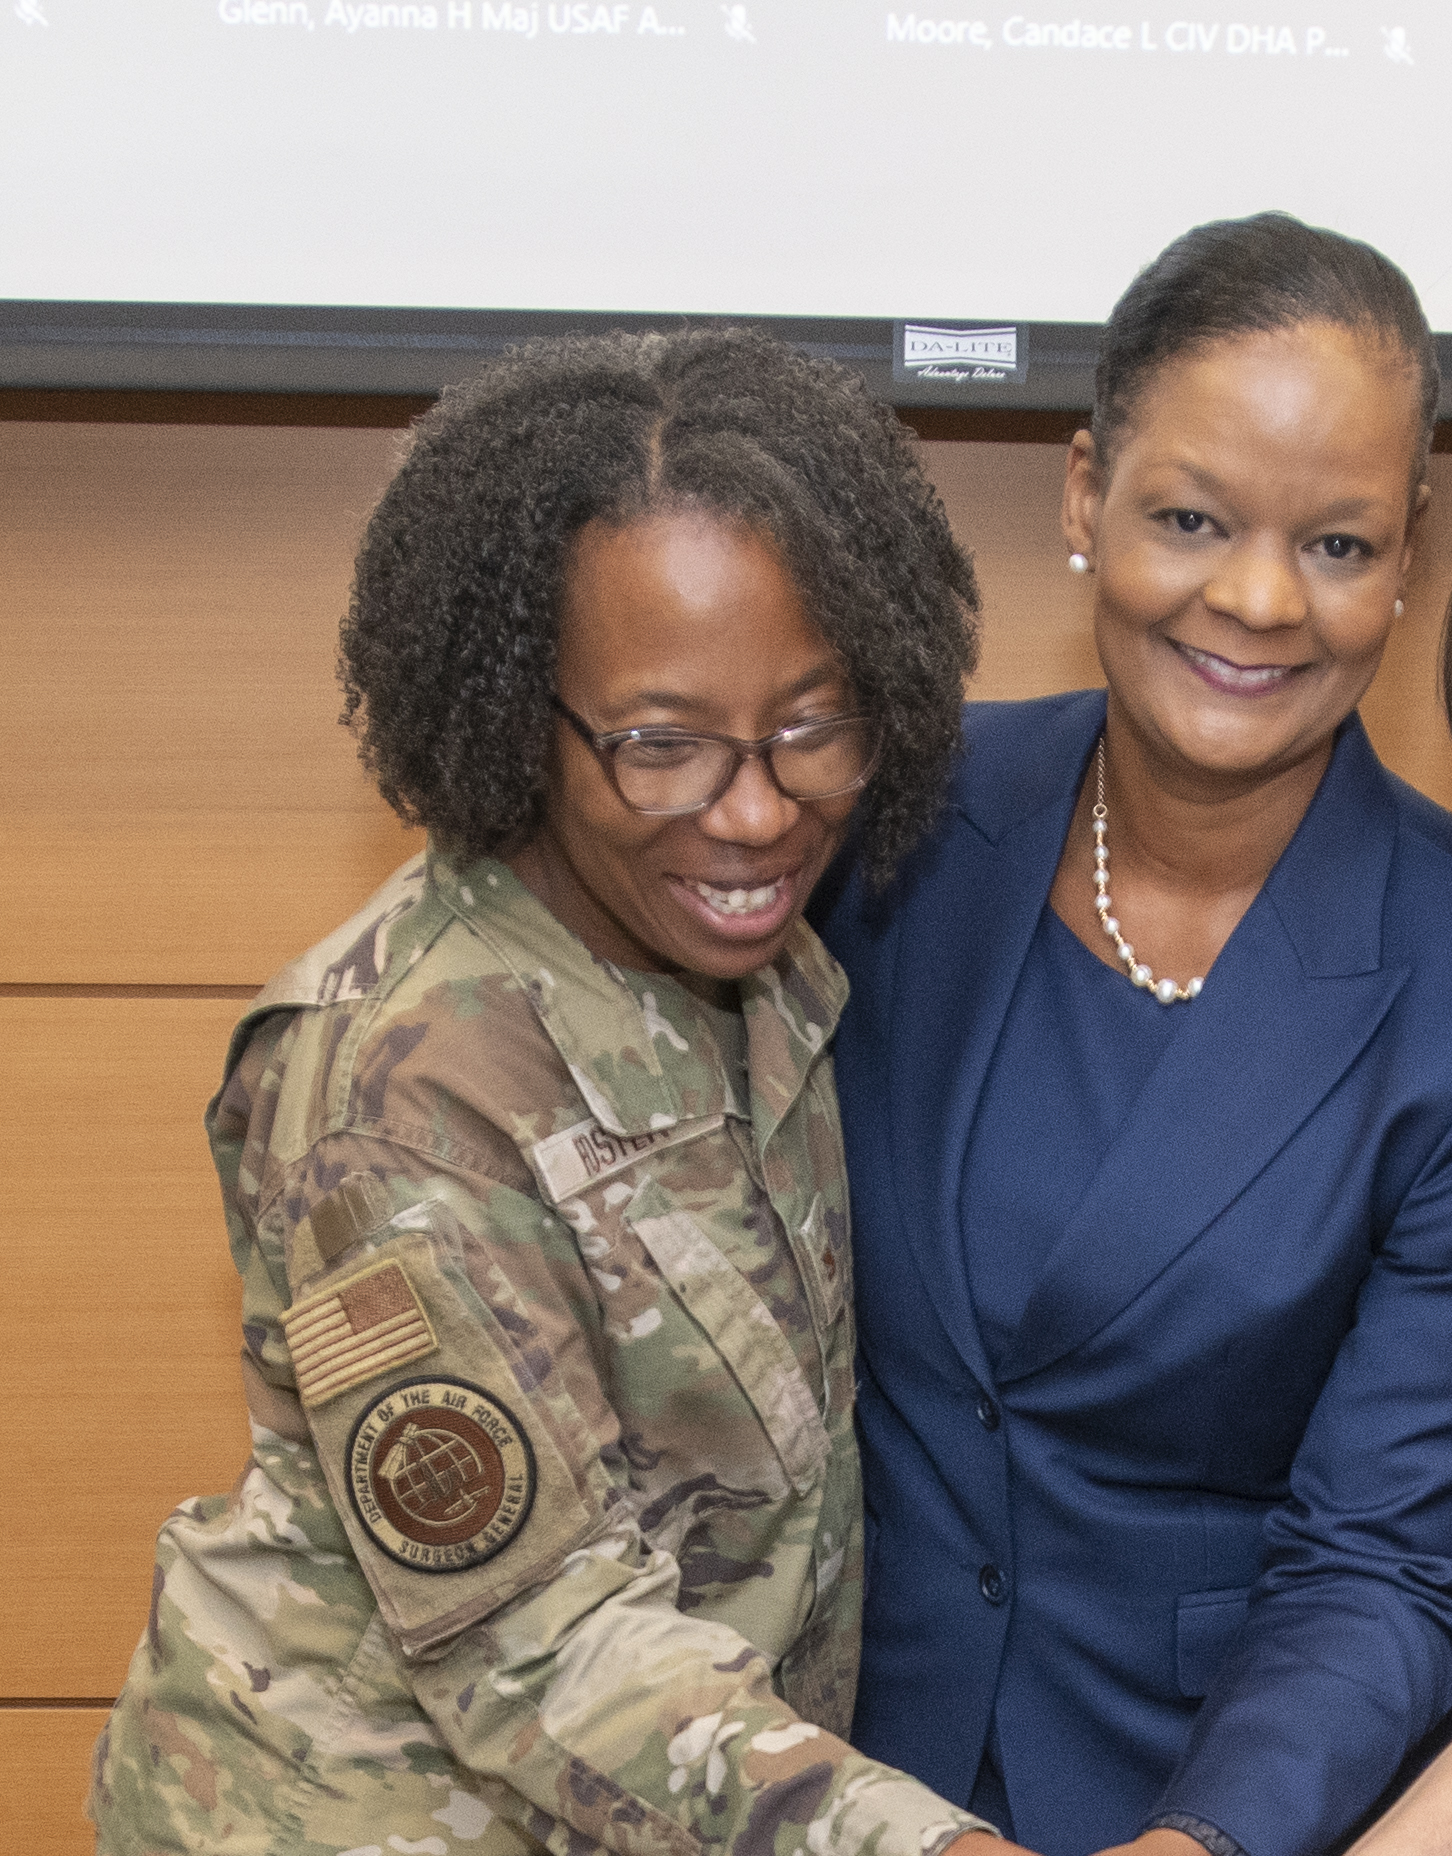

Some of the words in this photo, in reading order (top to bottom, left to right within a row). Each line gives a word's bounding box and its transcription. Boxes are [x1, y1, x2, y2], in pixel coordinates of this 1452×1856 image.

[218, 0, 315, 31] Glenn,
[325, 0, 439, 33] Ayanna
[448, 0, 472, 30] H
[482, 2, 539, 39] Maj
[548, 4, 628, 34] USAF
[887, 13, 993, 50] Moore,
[1003, 16, 1133, 50] Candace
[1141, 22, 1158, 51] L
[1165, 21, 1220, 53] CIV
[1226, 25, 1298, 55] DHA
[911, 341, 1013, 353] DA-LITE
[353, 1424, 384, 1525] DEPARTMENT
[377, 1404, 395, 1423] OF
[402, 1389, 431, 1408] THE
[441, 1390, 468, 1410] AIR
[472, 1404, 515, 1450] FORCE
